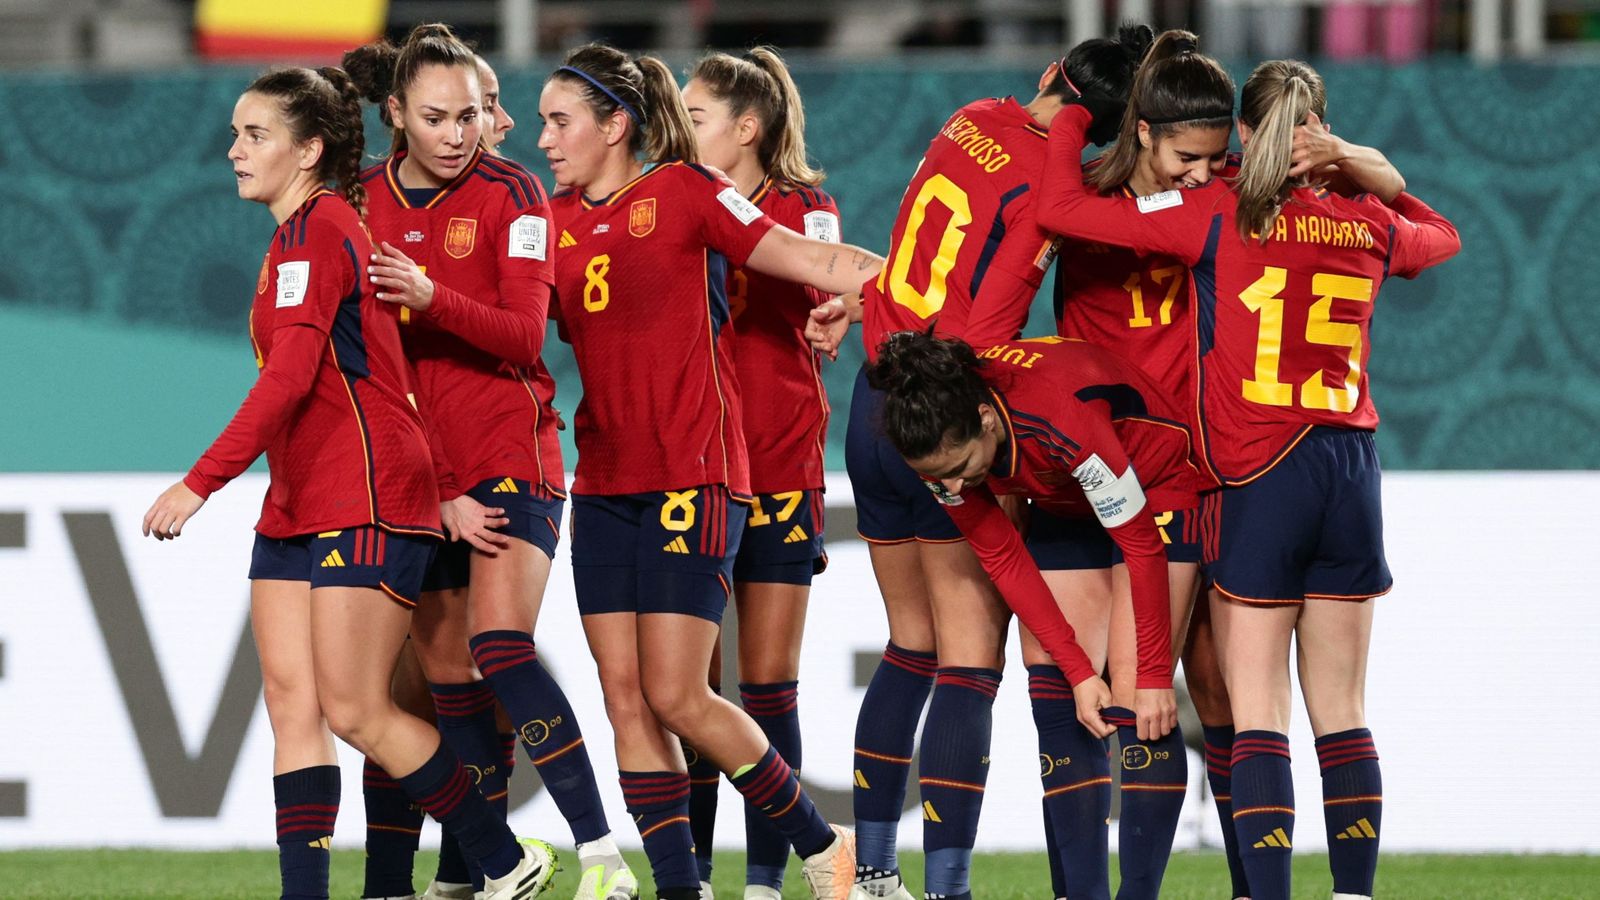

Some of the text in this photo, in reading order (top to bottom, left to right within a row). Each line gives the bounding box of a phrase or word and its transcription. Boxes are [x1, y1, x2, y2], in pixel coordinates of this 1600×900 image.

[943, 115, 1012, 173] HERMOSO
[876, 157, 973, 320] 0
[1295, 215, 1374, 250] NAVARRO
[583, 253, 611, 313] 8
[1122, 264, 1185, 328] 17
[1237, 265, 1374, 414] 15
[660, 488, 699, 532] 8
